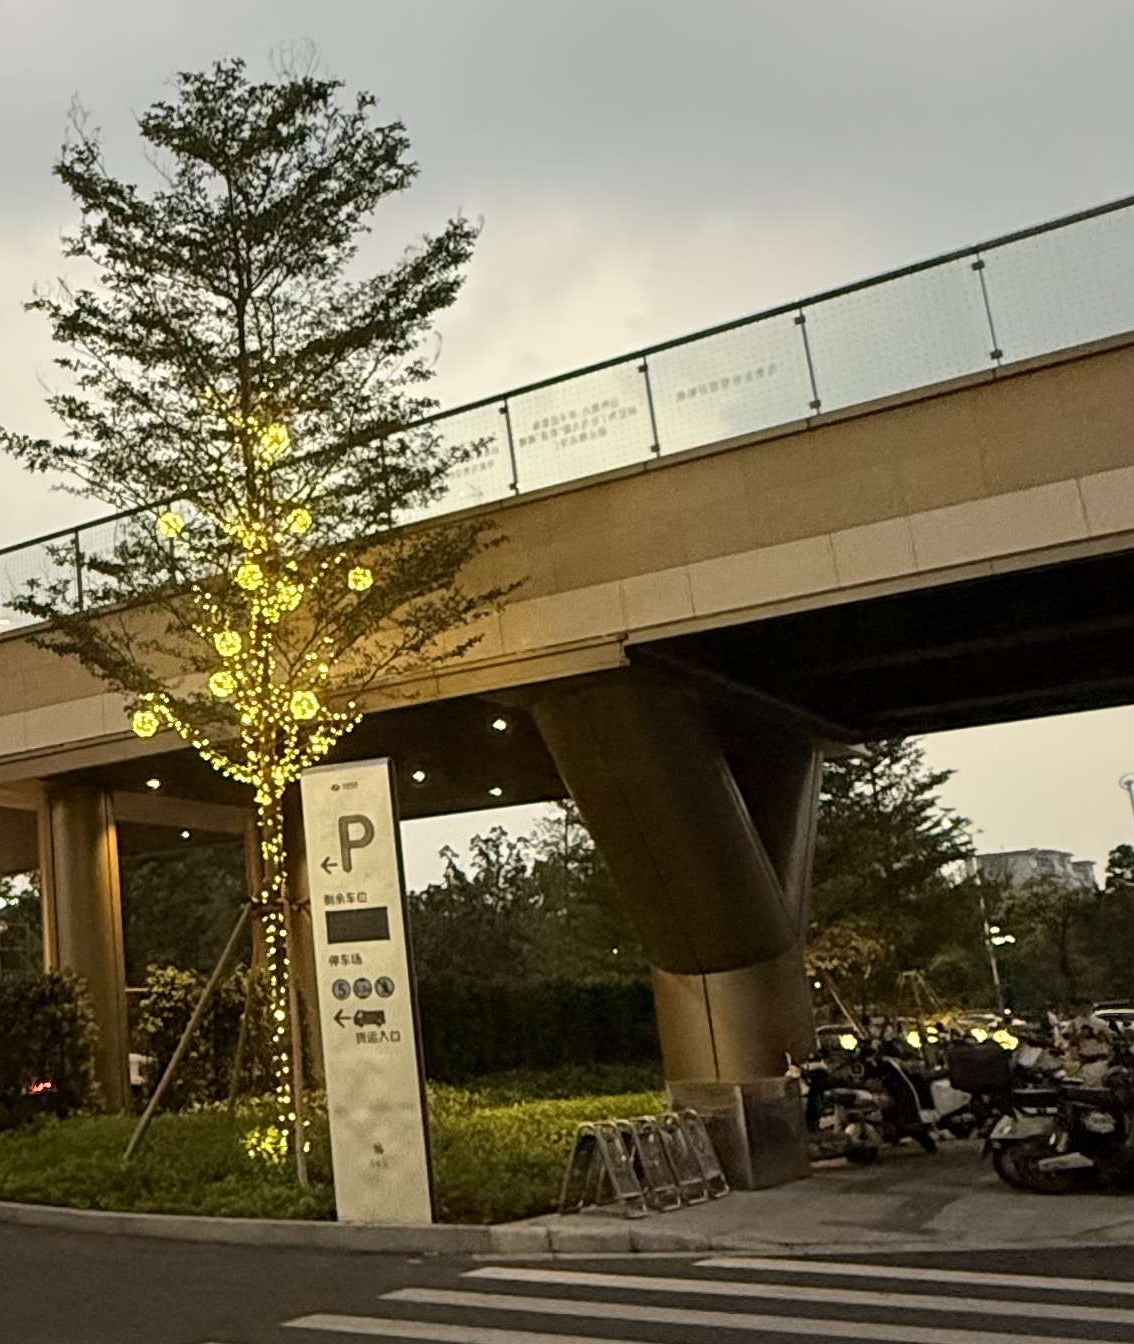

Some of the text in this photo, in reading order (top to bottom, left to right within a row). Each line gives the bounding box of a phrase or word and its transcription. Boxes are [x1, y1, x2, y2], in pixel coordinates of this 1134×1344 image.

[338, 815, 374, 873] P
[324, 892, 368, 906] 剩余车位
[329, 954, 363, 967] 停车场
[356, 1030, 401, 1045] 货运入口
